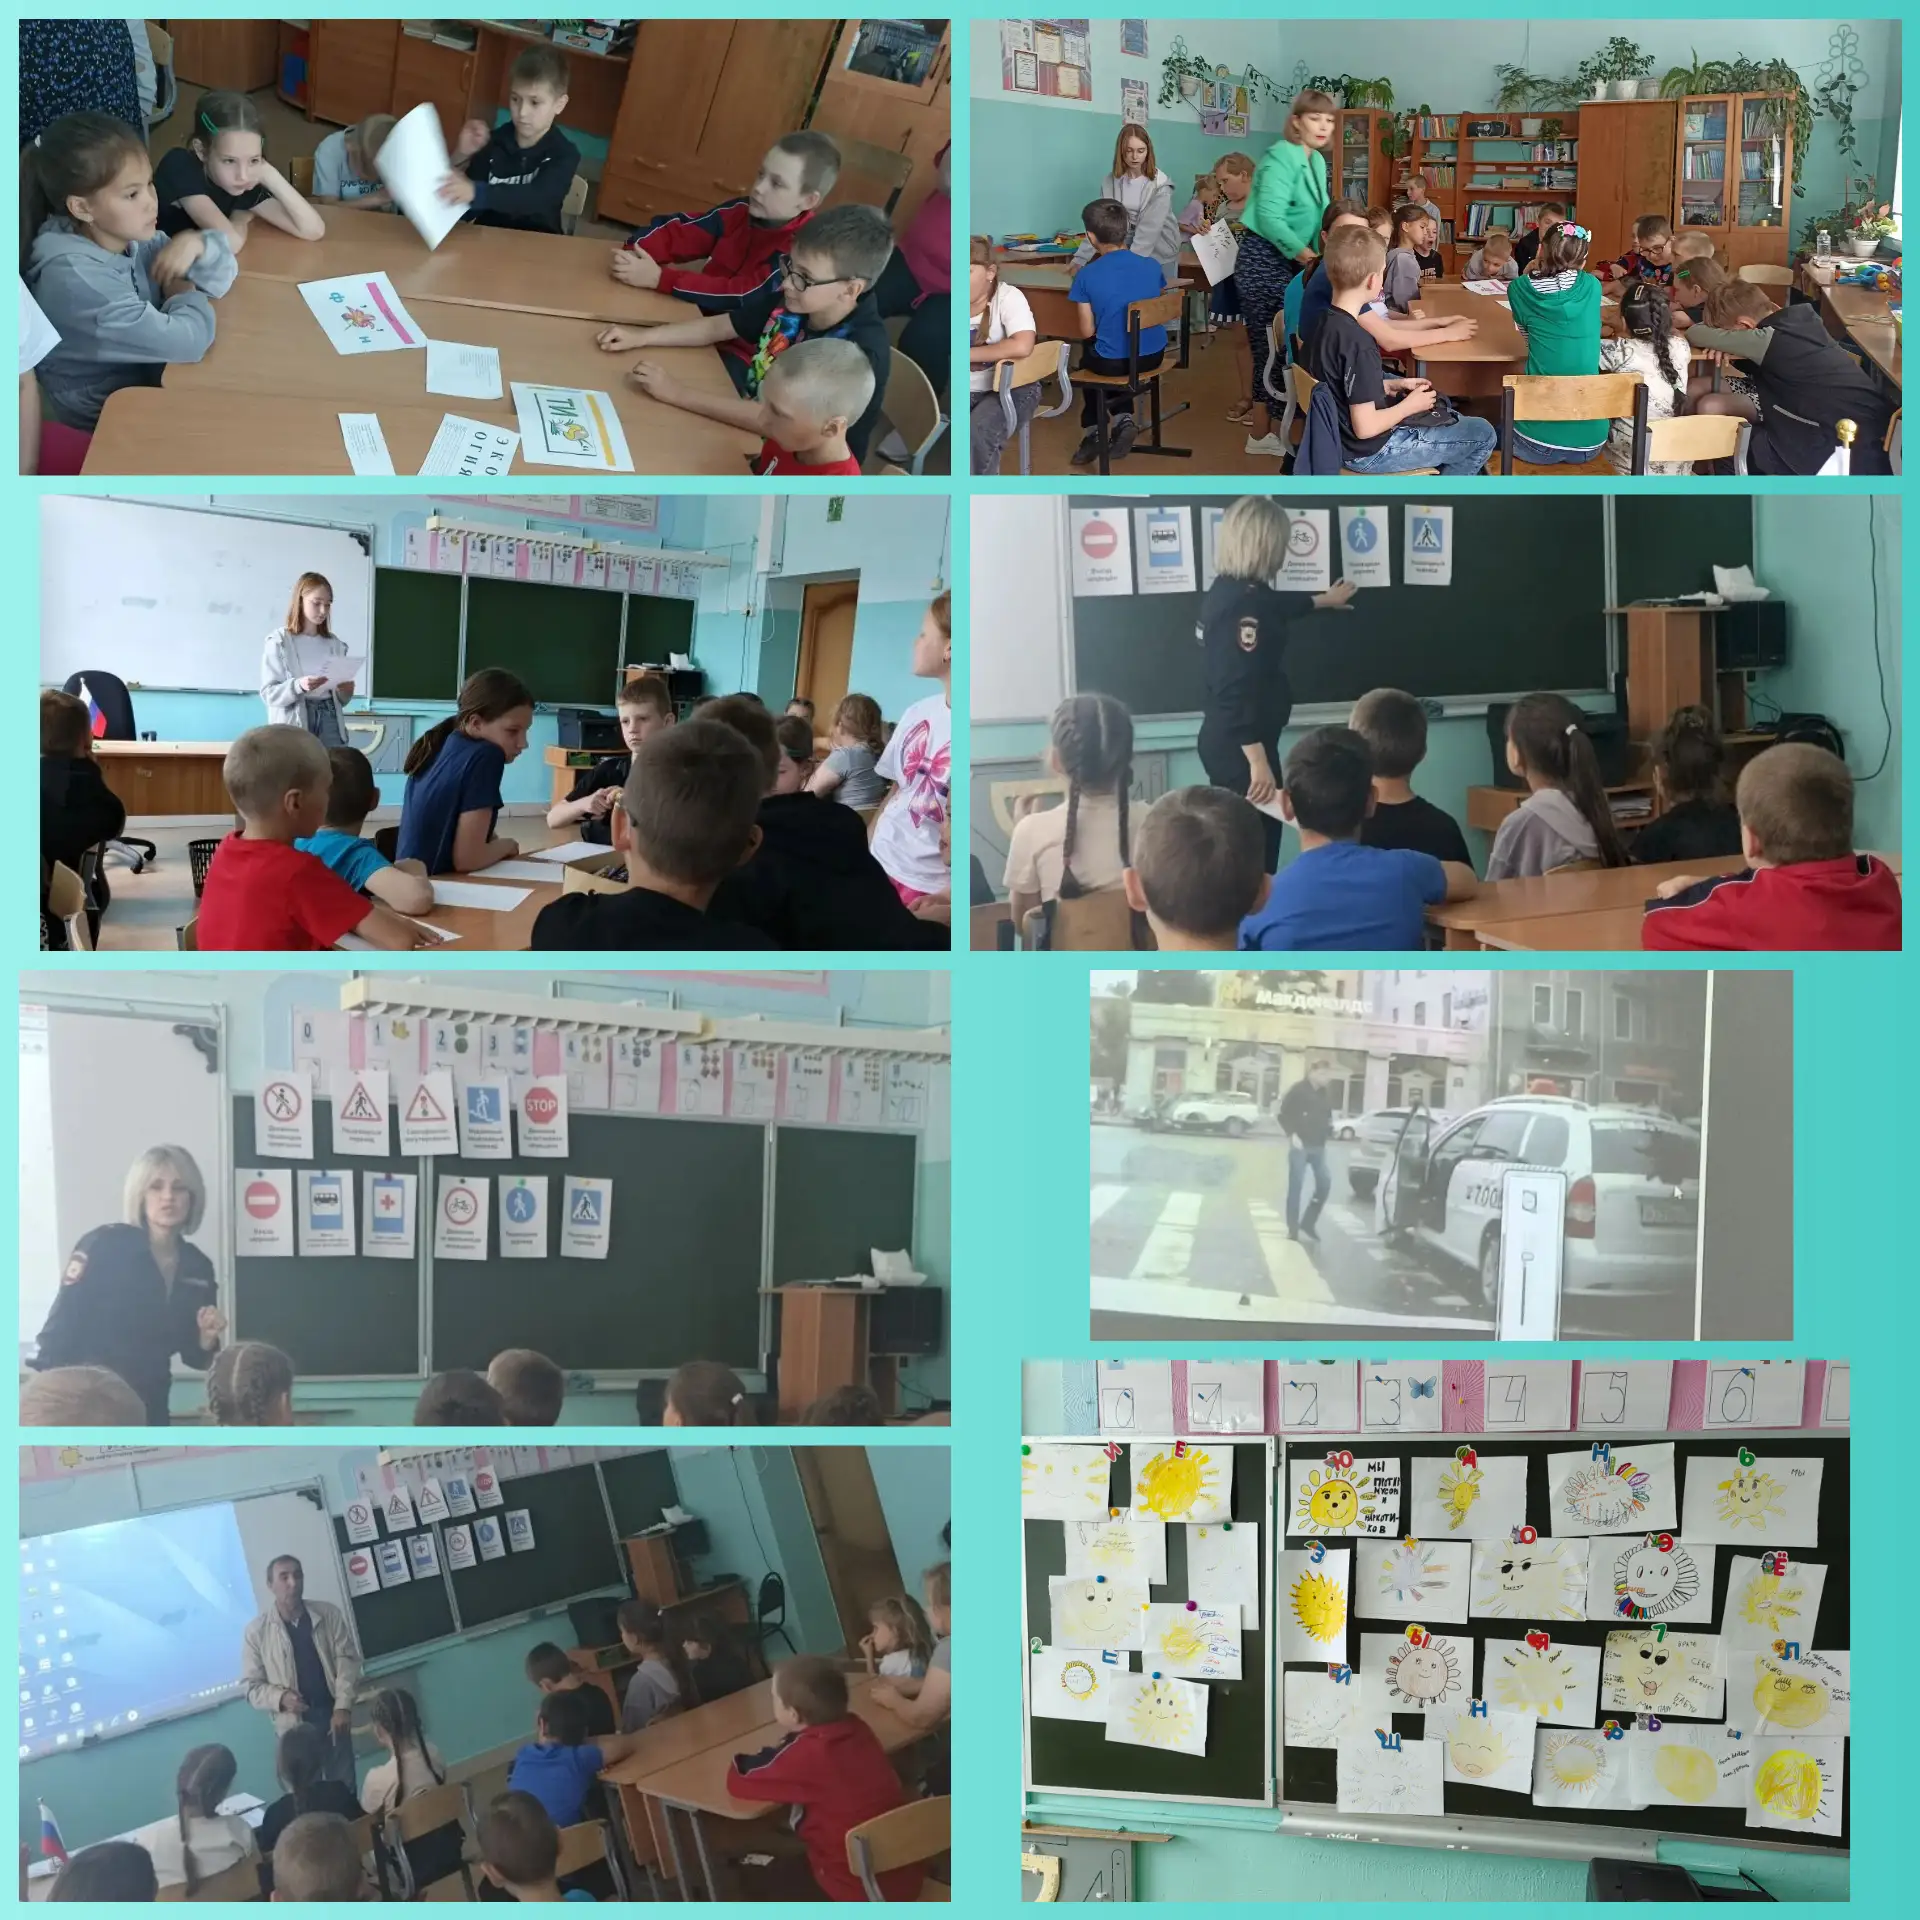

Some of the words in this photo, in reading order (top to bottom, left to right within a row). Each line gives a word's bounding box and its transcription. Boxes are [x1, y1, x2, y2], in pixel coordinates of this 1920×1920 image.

[526, 1099, 556, 1112] STOP
[1461, 1450, 1477, 1468] А
[1592, 1443, 1609, 1462] Н
[1367, 1461, 1385, 1472] МЫ
[1471, 1701, 1487, 1717] Н
